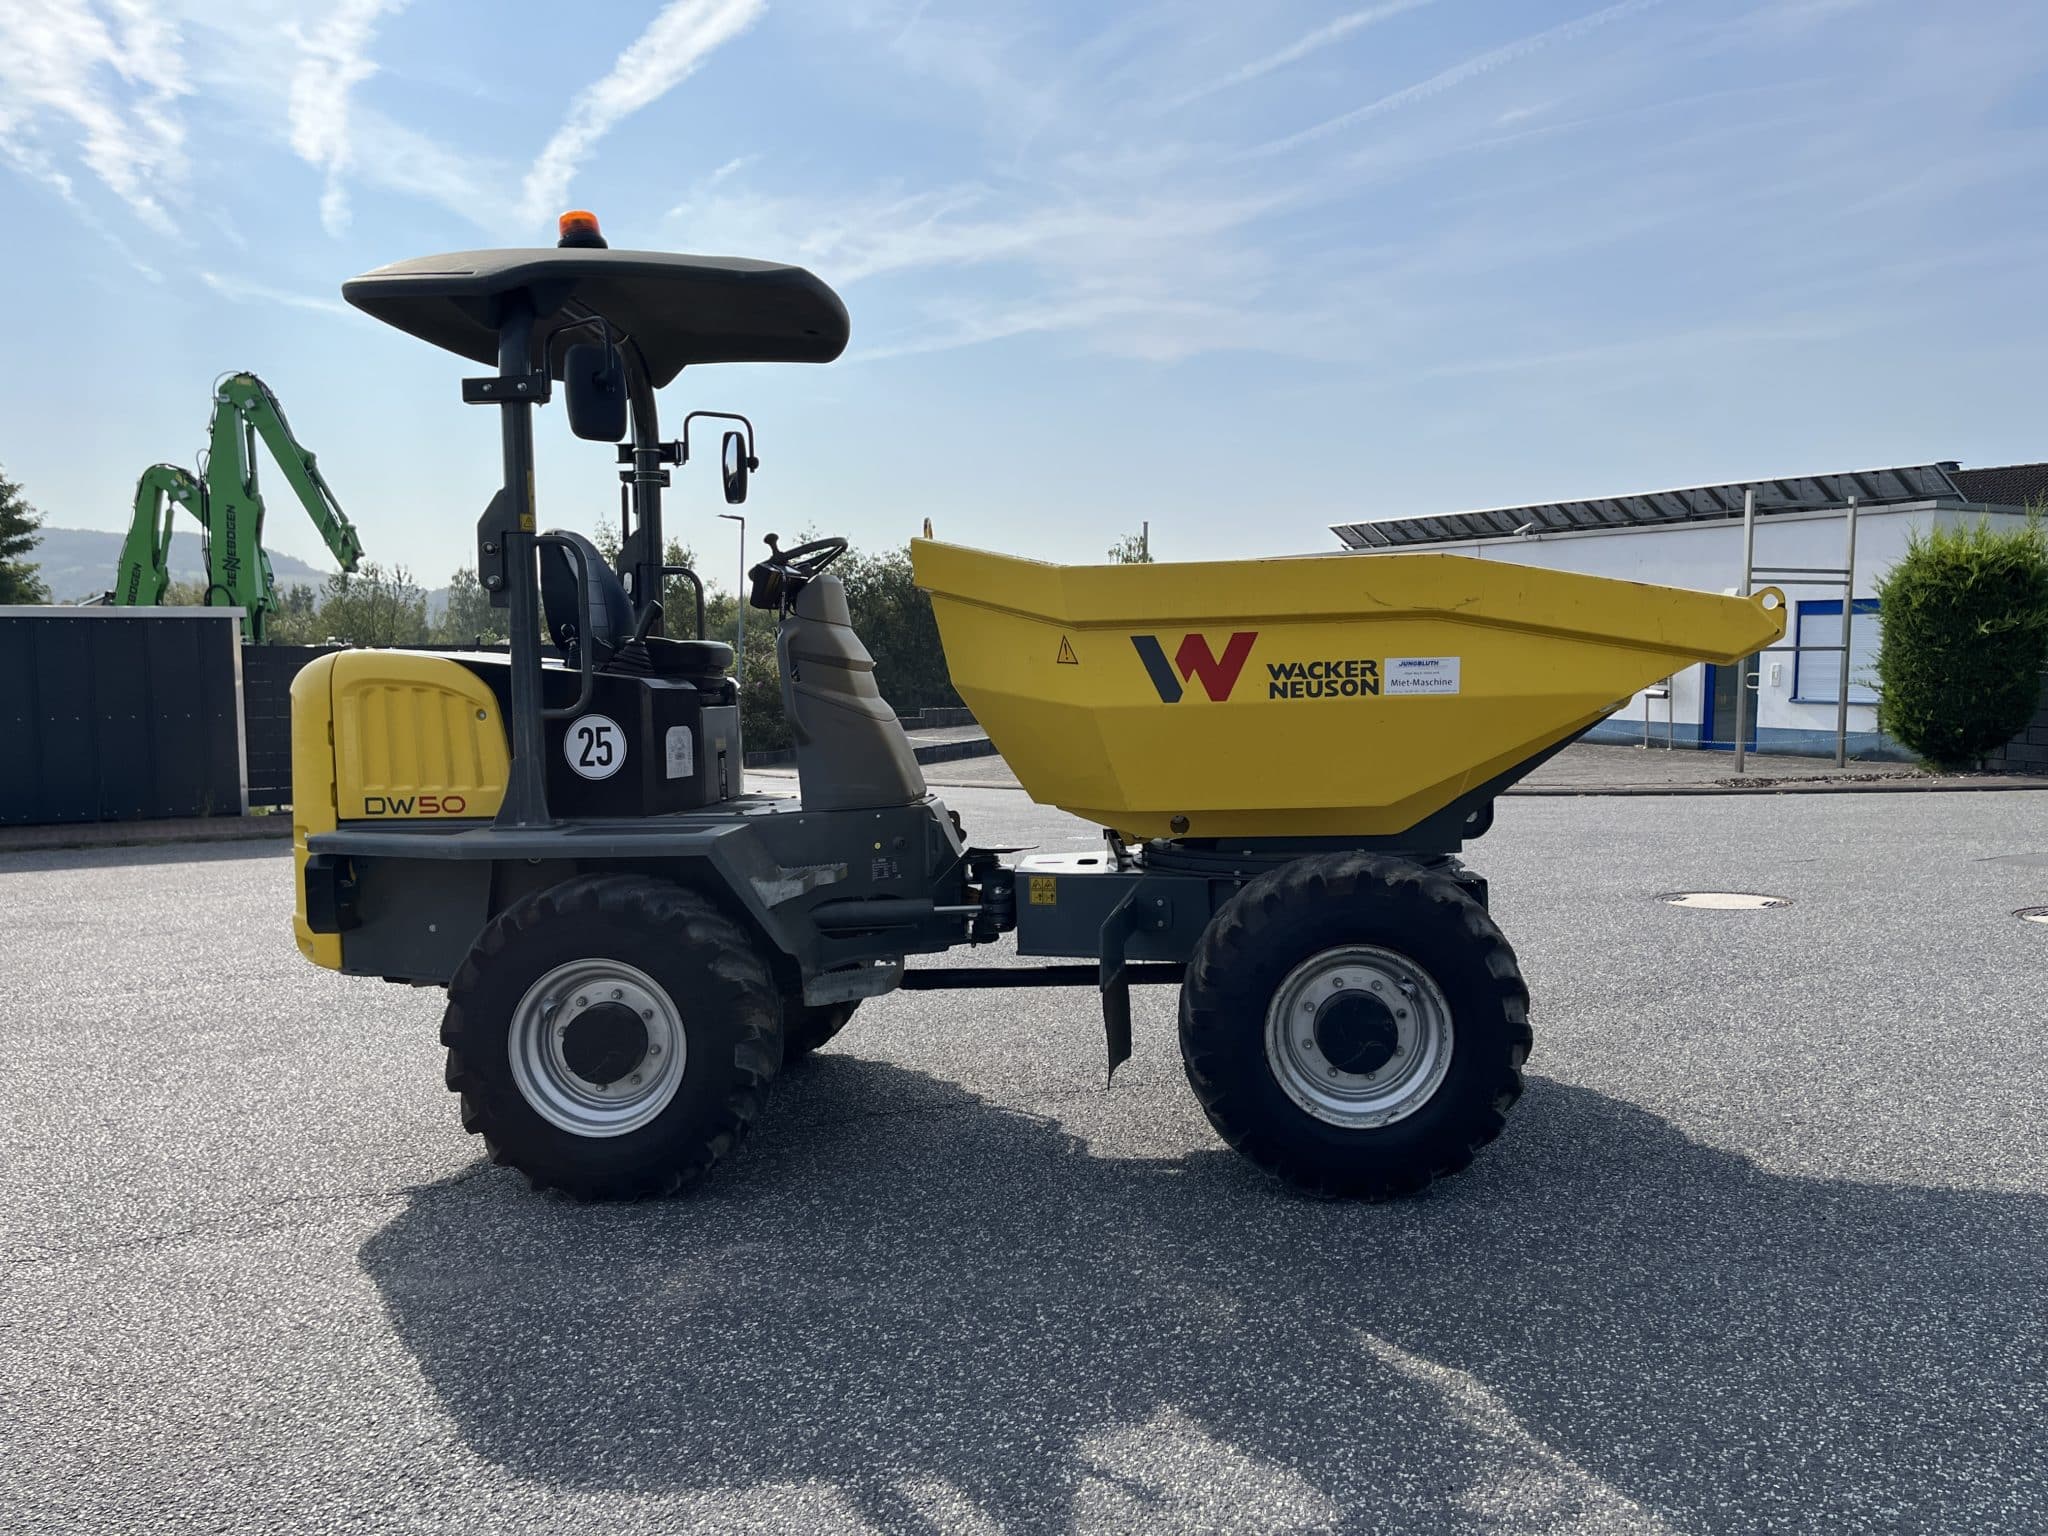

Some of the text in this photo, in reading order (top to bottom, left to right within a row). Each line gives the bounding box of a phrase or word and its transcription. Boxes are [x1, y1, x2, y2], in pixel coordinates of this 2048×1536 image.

[222, 504, 240, 588] SENNEBOGEN
[1265, 660, 1379, 681] WACKER
[1269, 678, 1379, 699] NEUSON
[1390, 678, 1453, 687] Miet-Maschine
[577, 726, 613, 767] 25
[364, 795, 466, 815] DW50
